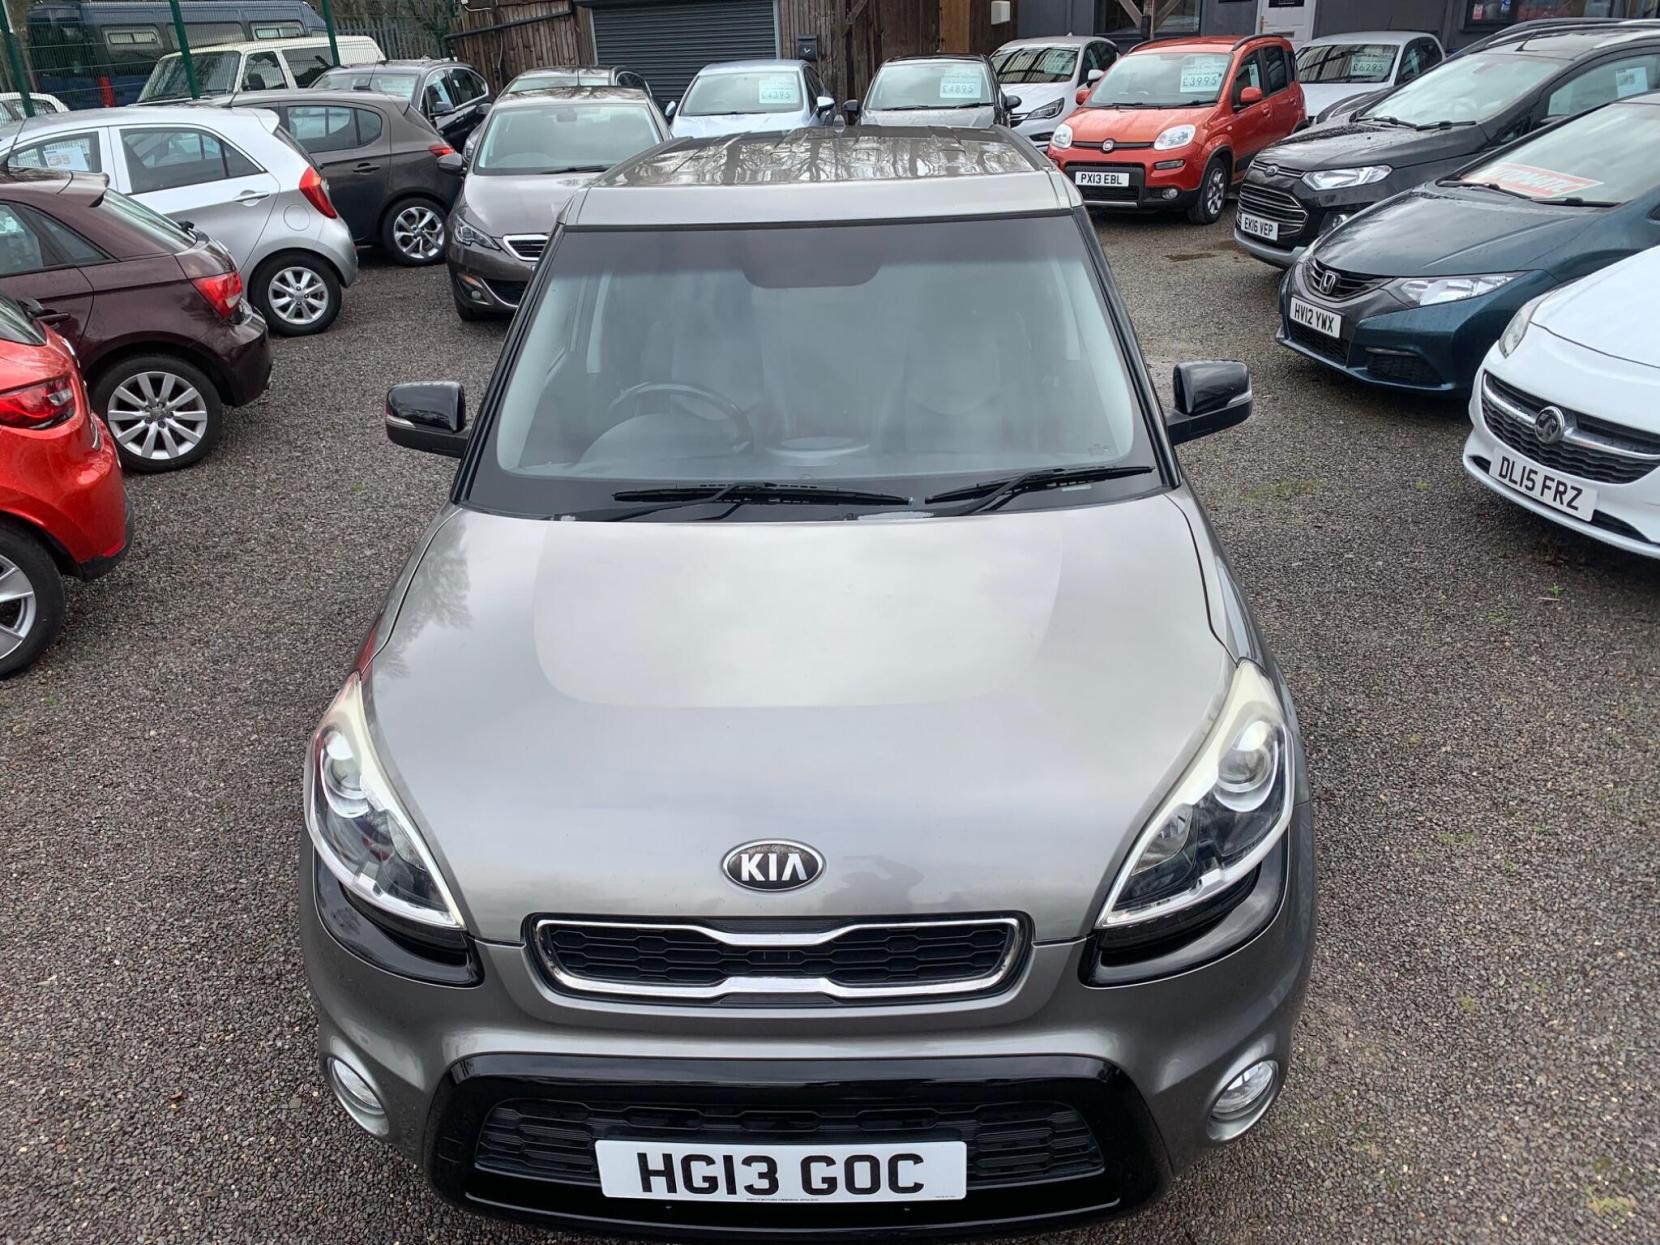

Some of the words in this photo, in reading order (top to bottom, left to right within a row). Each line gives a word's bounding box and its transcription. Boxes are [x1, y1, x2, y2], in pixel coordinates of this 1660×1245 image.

[1183, 76, 1217, 87] £3995
[1080, 173, 1102, 184] PX13
[1103, 174, 1123, 185] EBL
[1244, 217, 1258, 232] EK16
[1259, 221, 1273, 236] VEP
[1315, 310, 1334, 333] YWX
[1498, 456, 1538, 492] DL15
[1540, 475, 1583, 511] FRZ
[740, 853, 808, 881] KIA
[636, 1152, 779, 1196] HG13
[800, 1153, 924, 1196] GOC
